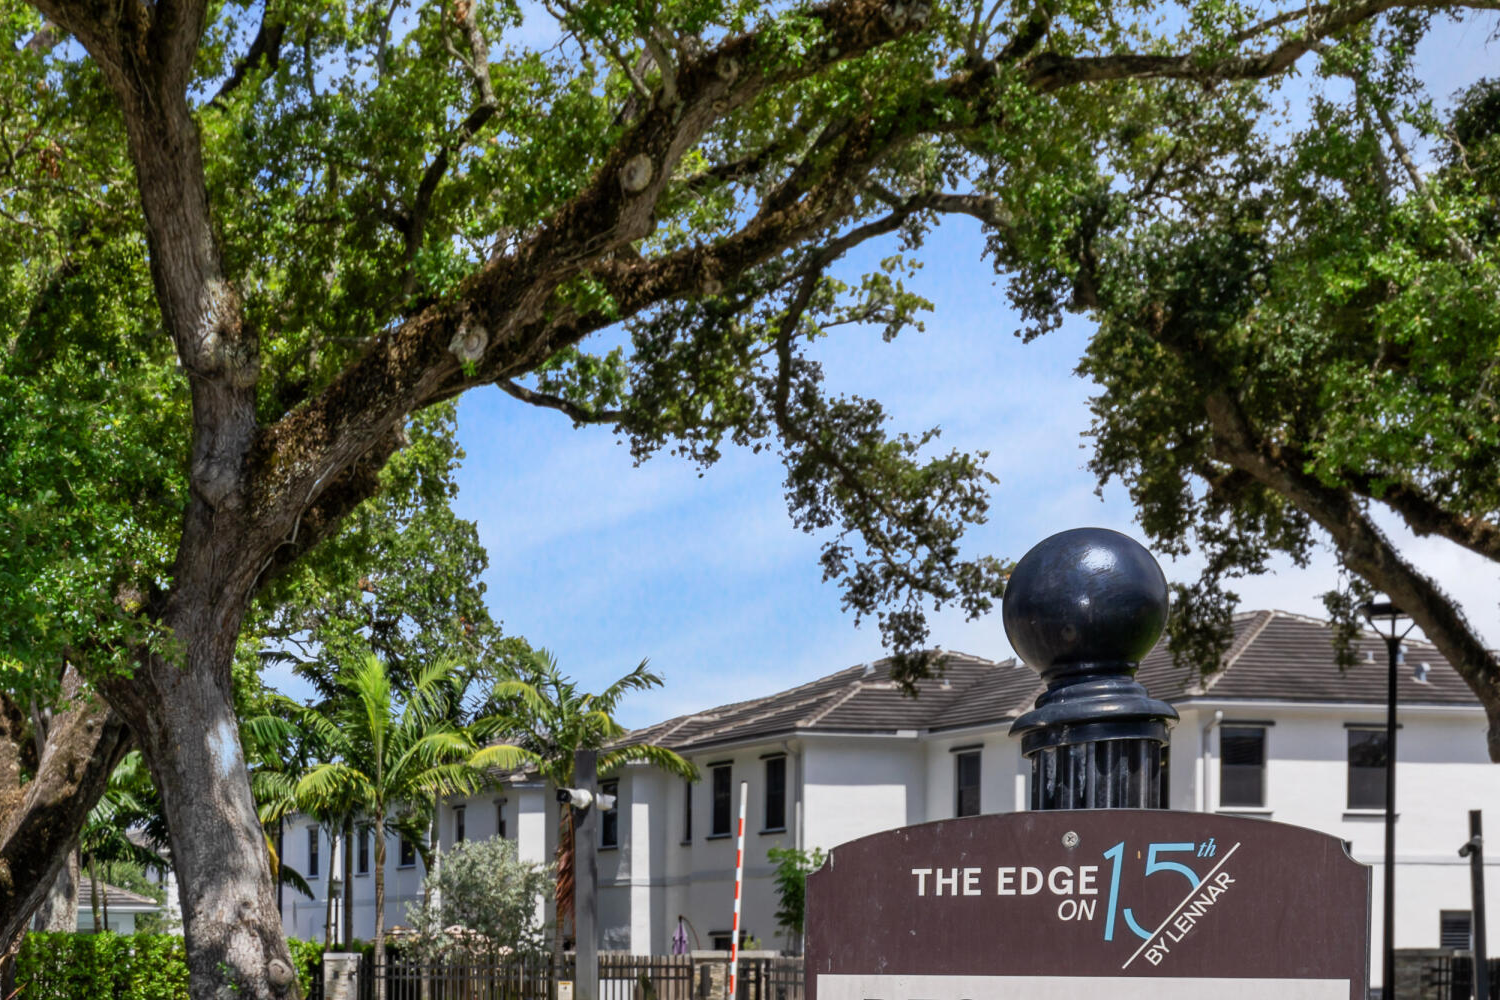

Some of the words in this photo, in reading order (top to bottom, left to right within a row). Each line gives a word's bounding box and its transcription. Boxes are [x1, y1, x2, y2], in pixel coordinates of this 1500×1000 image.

[911, 867, 982, 897] THE
[997, 865, 1099, 896] EDGE
[1057, 899, 1097, 922] ON
[1145, 939, 1171, 967] BY
[1166, 870, 1236, 943] LENNAR
